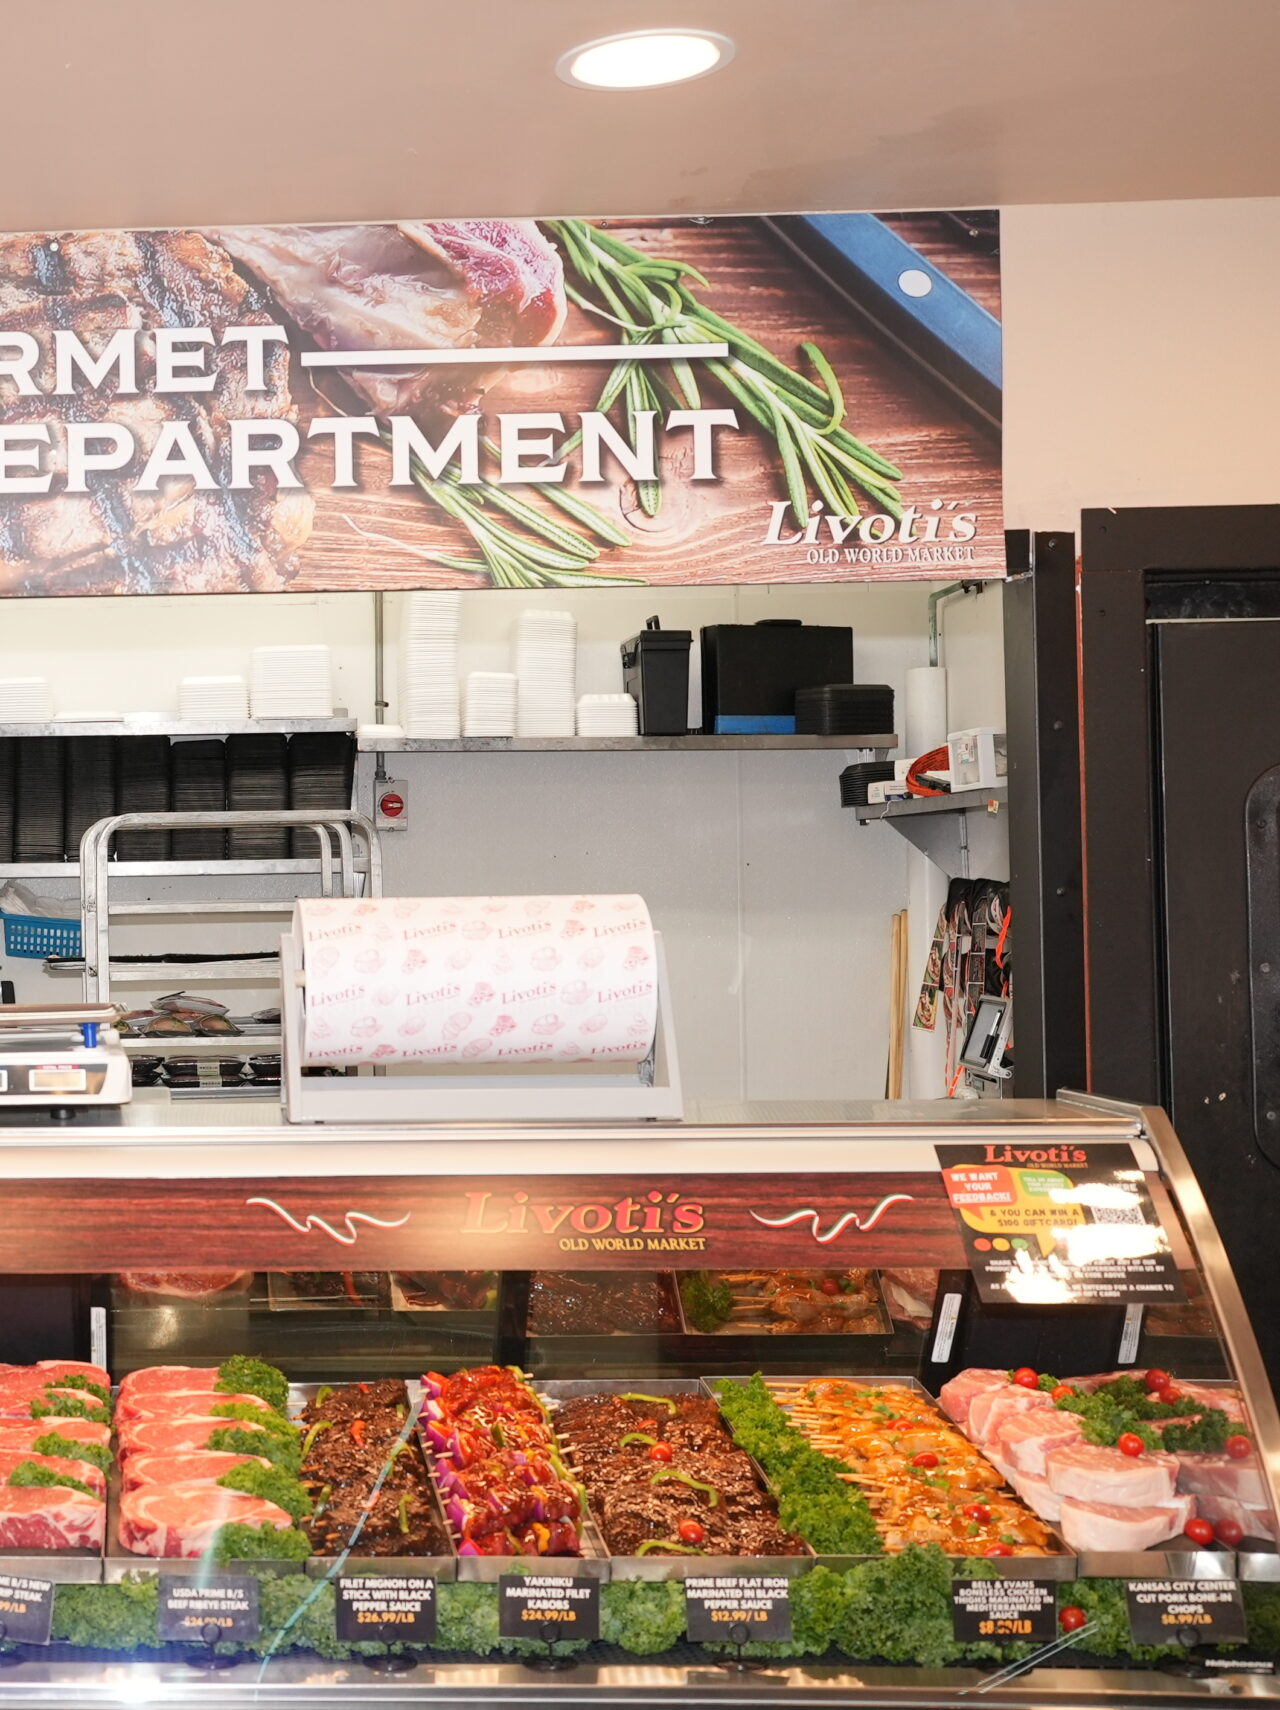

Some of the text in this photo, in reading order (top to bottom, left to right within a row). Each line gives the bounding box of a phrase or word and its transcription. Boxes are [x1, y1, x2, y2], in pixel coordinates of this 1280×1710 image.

[762, 499, 977, 545] Livoti's
[807, 546, 976, 564] OLD WORLD MARKET
[984, 1144, 1087, 1163] Livoti's
[950, 1171, 999, 1182] WE WANT
[964, 1182, 992, 1191] YOUR
[952, 1192, 1012, 1202] FEEDBACK!
[459, 1190, 705, 1234] Livoti's
[1050, 1208, 1068, 1216] WIN
[559, 1238, 706, 1251] OLD WORLD MARKET
[11, 1577, 28, 1589] B/S
[28, 1579, 51, 1591] NEW
[340, 1578, 434, 1589] FILET MIGNON ON A
[523, 1576, 573, 1587] YAKINIKU
[685, 1577, 788, 1587] PRIME BEEF FLAT IRON
[971, 1580, 991, 1589] BELL
[1003, 1580, 1035, 1589] EVANS
[1128, 1581, 1236, 1592] KANSAS CITY CENTER
[13, 1589, 42, 1602] STEAK
[173, 1588, 244, 1599] USDA PRIME B/S
[342, 1590, 431, 1601] STICK WITH BLACK
[505, 1587, 591, 1599] MARINATED FILET
[687, 1588, 788, 1598] MARINATED IN BLACK
[959, 1588, 1047, 1596] BONELESS CHICKEN
[1136, 1592, 1233, 1603] CUT PORK BONE-IN
[167, 1599, 249, 1610] BEEF RIBEYE STEAK
[527, 1599, 570, 1610] KABOBS
[704, 1599, 773, 1609] PEPPER SAUCE
[953, 1596, 1054, 1604] THIGHS MARINATED IN
[352, 1601, 421, 1612] PEPPER SAUCE
[966, 1604, 1041, 1612] MEDITERRANEAN
[1167, 1604, 1204, 1614] CHOPS
[357, 1612, 415, 1624] $26.99/LB
[521, 1609, 576, 1622] $24.99/LB
[754, 1611, 768, 1622] LB
[989, 1611, 1019, 1619] SAUCE
